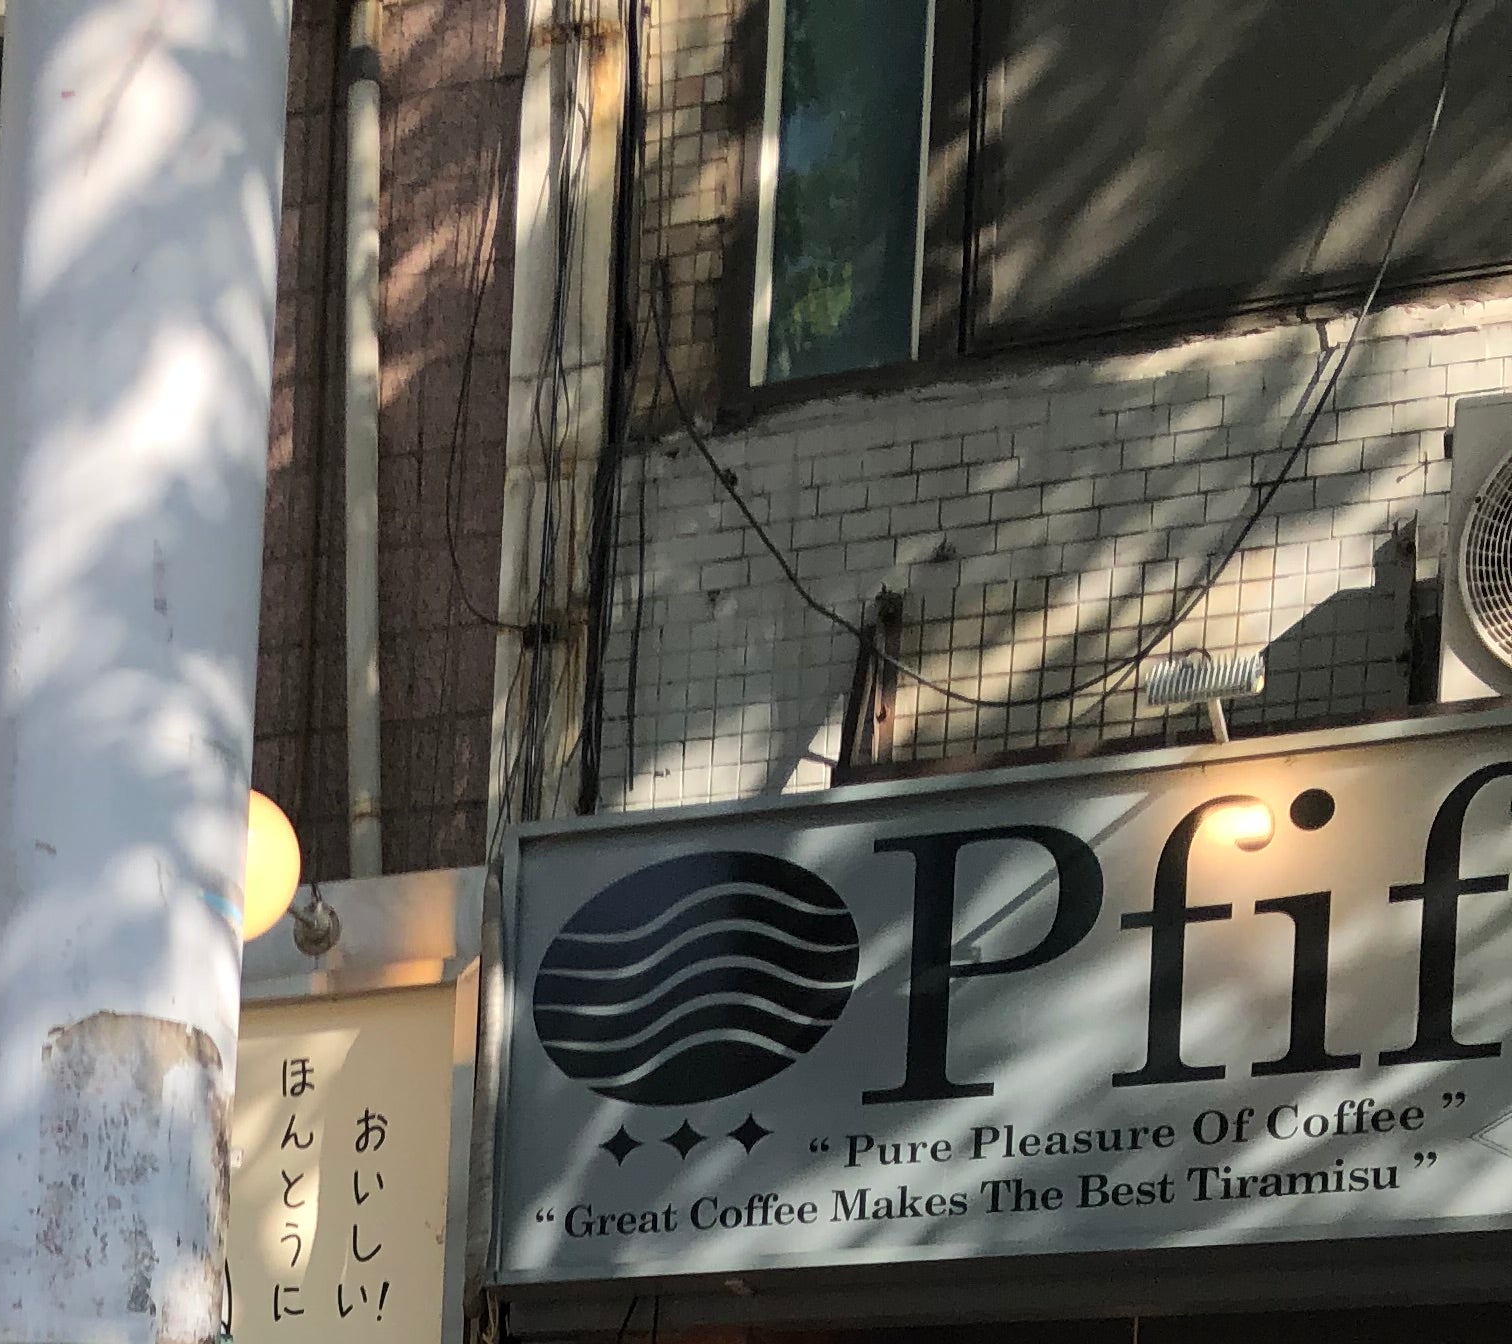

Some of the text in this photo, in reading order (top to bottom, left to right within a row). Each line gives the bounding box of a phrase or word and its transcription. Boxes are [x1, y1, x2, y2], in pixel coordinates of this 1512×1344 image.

[843, 1134, 953, 1168] Pure
[969, 1123, 1176, 1160] Pleasure
[1192, 1107, 1255, 1145] Of
[1266, 1098, 1425, 1139] Coffee
[272, 1056, 316, 1322] ほんとうに
[689, 1192, 819, 1231] Coffee
[830, 1185, 969, 1223] Makes
[980, 1177, 1065, 1214] The
[1075, 1172, 1176, 1209] Best
[1187, 1157, 1400, 1202] Tiramisu
